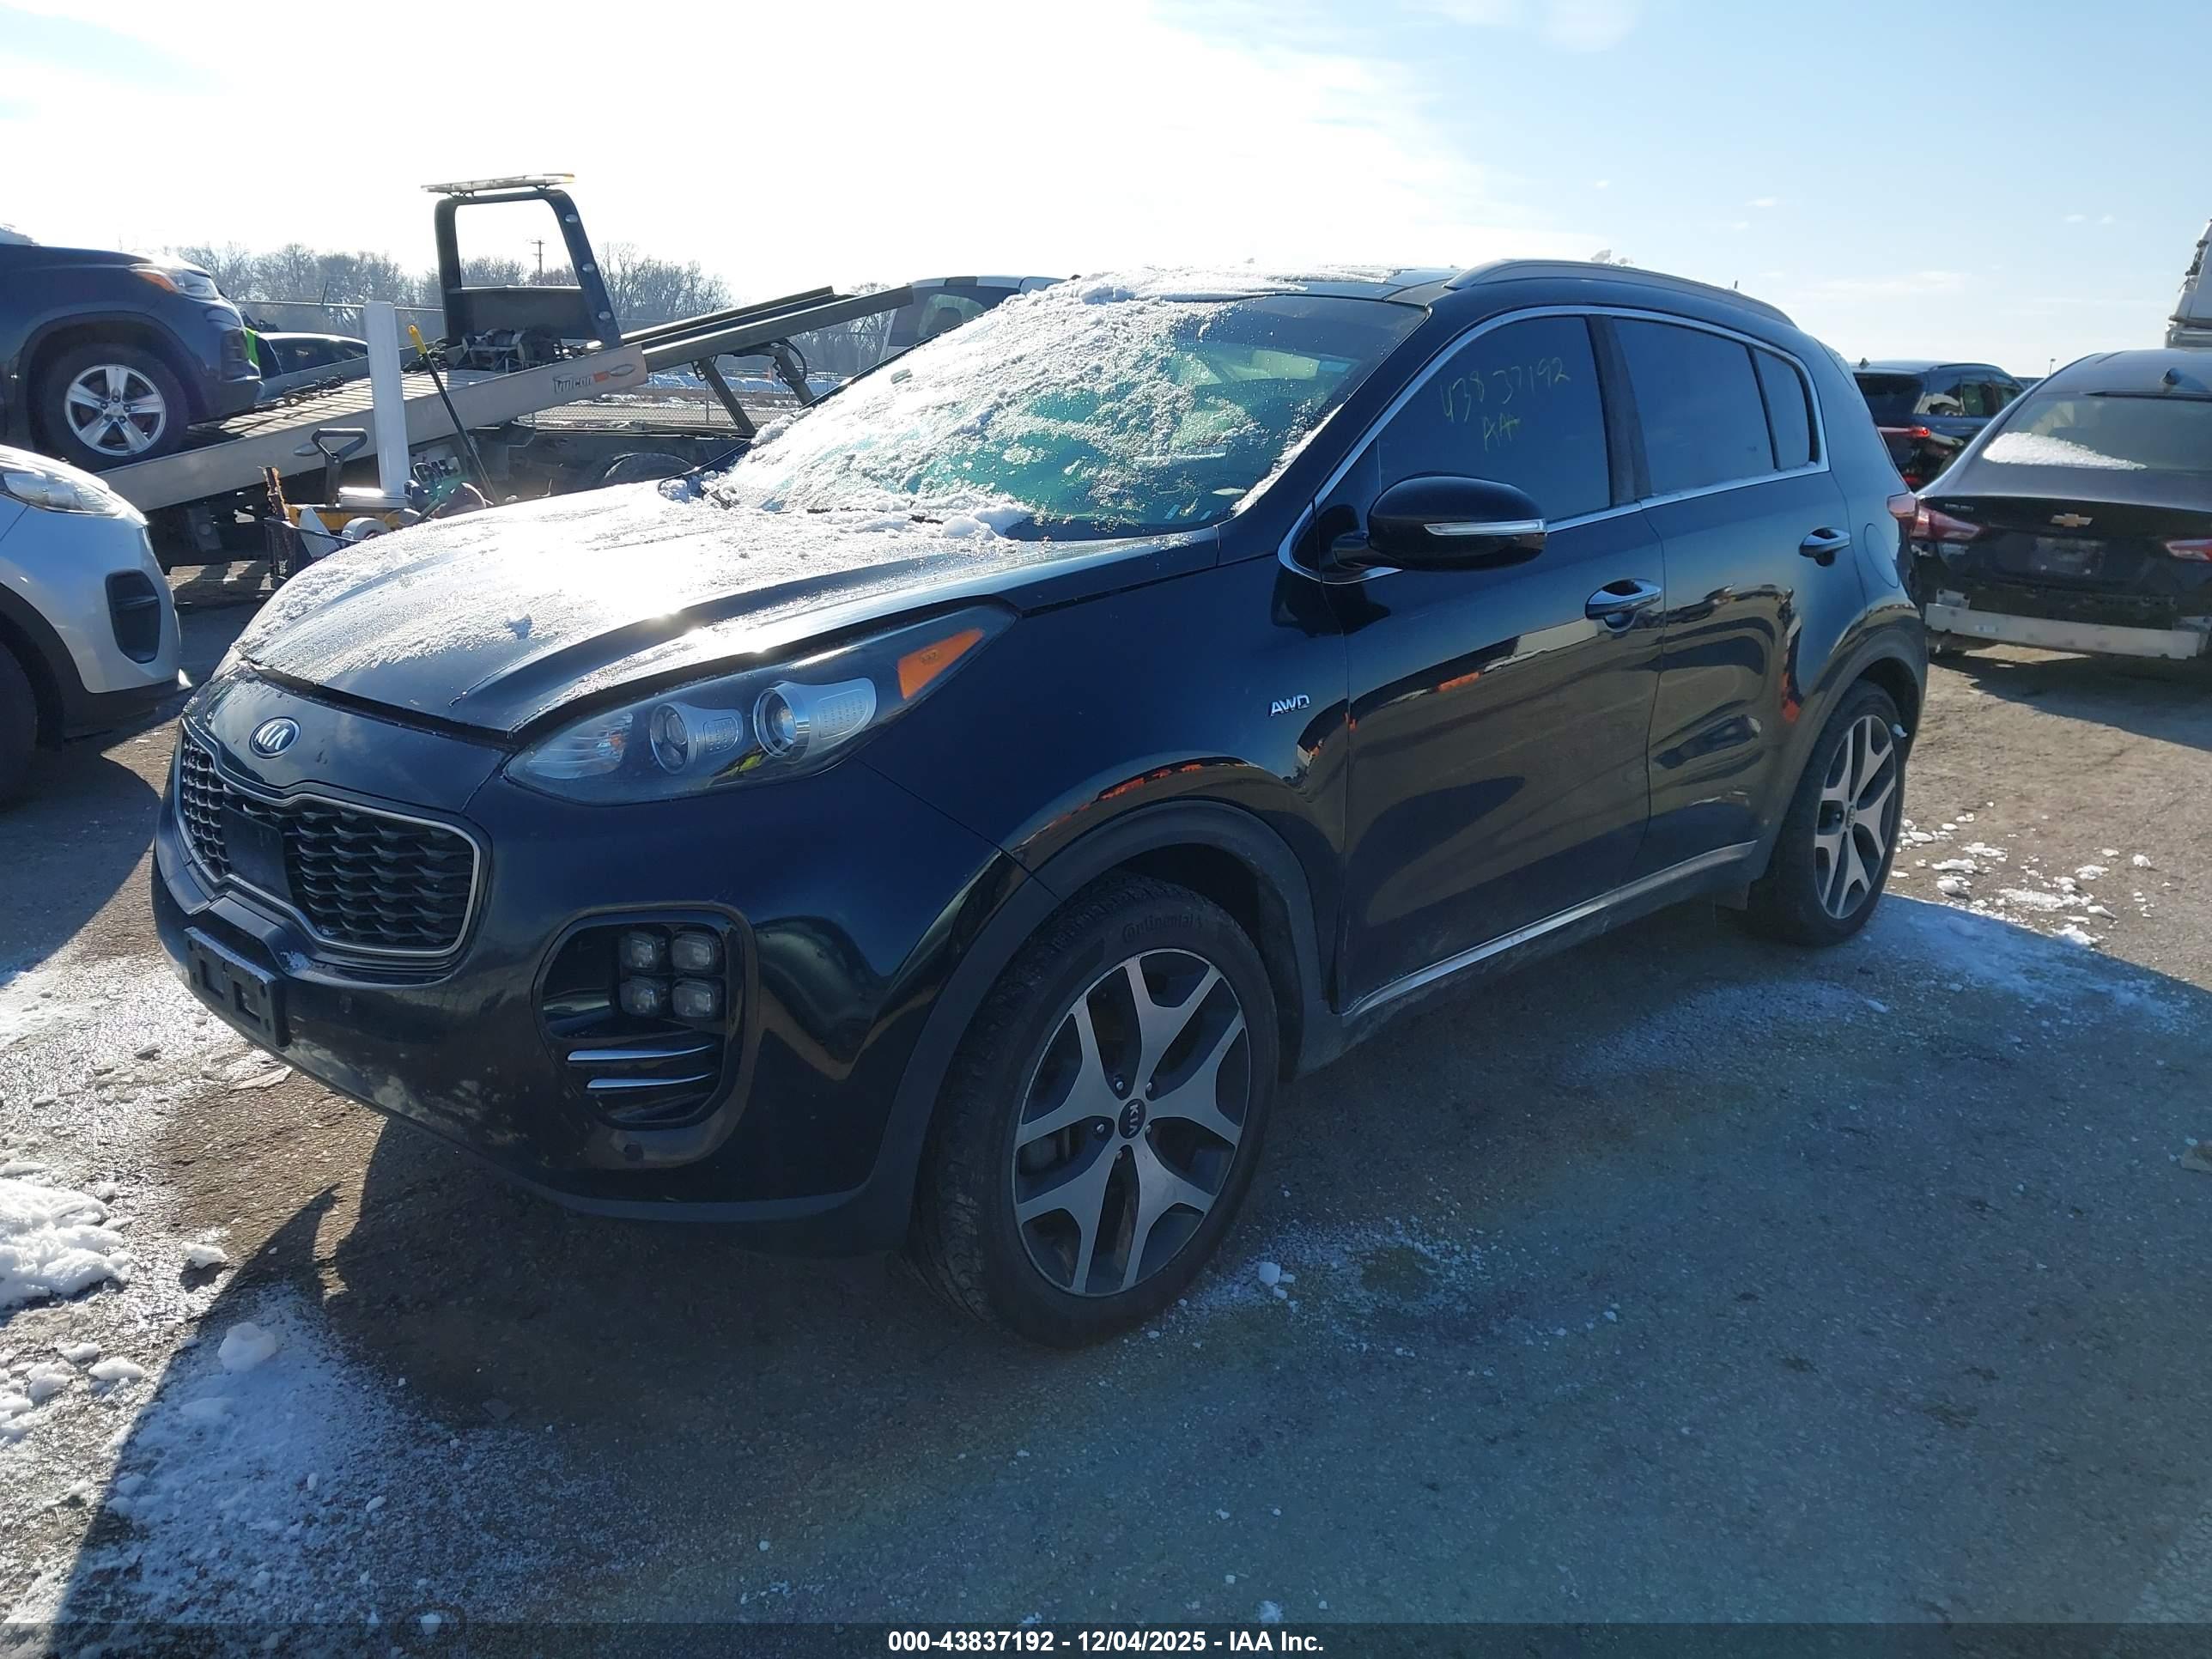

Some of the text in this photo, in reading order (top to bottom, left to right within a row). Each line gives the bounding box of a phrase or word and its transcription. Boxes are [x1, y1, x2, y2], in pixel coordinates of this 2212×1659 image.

[1270, 694, 1310, 717] AWD
[254, 723, 290, 750] KIA
[1128, 1103, 1139, 1135] KIA
